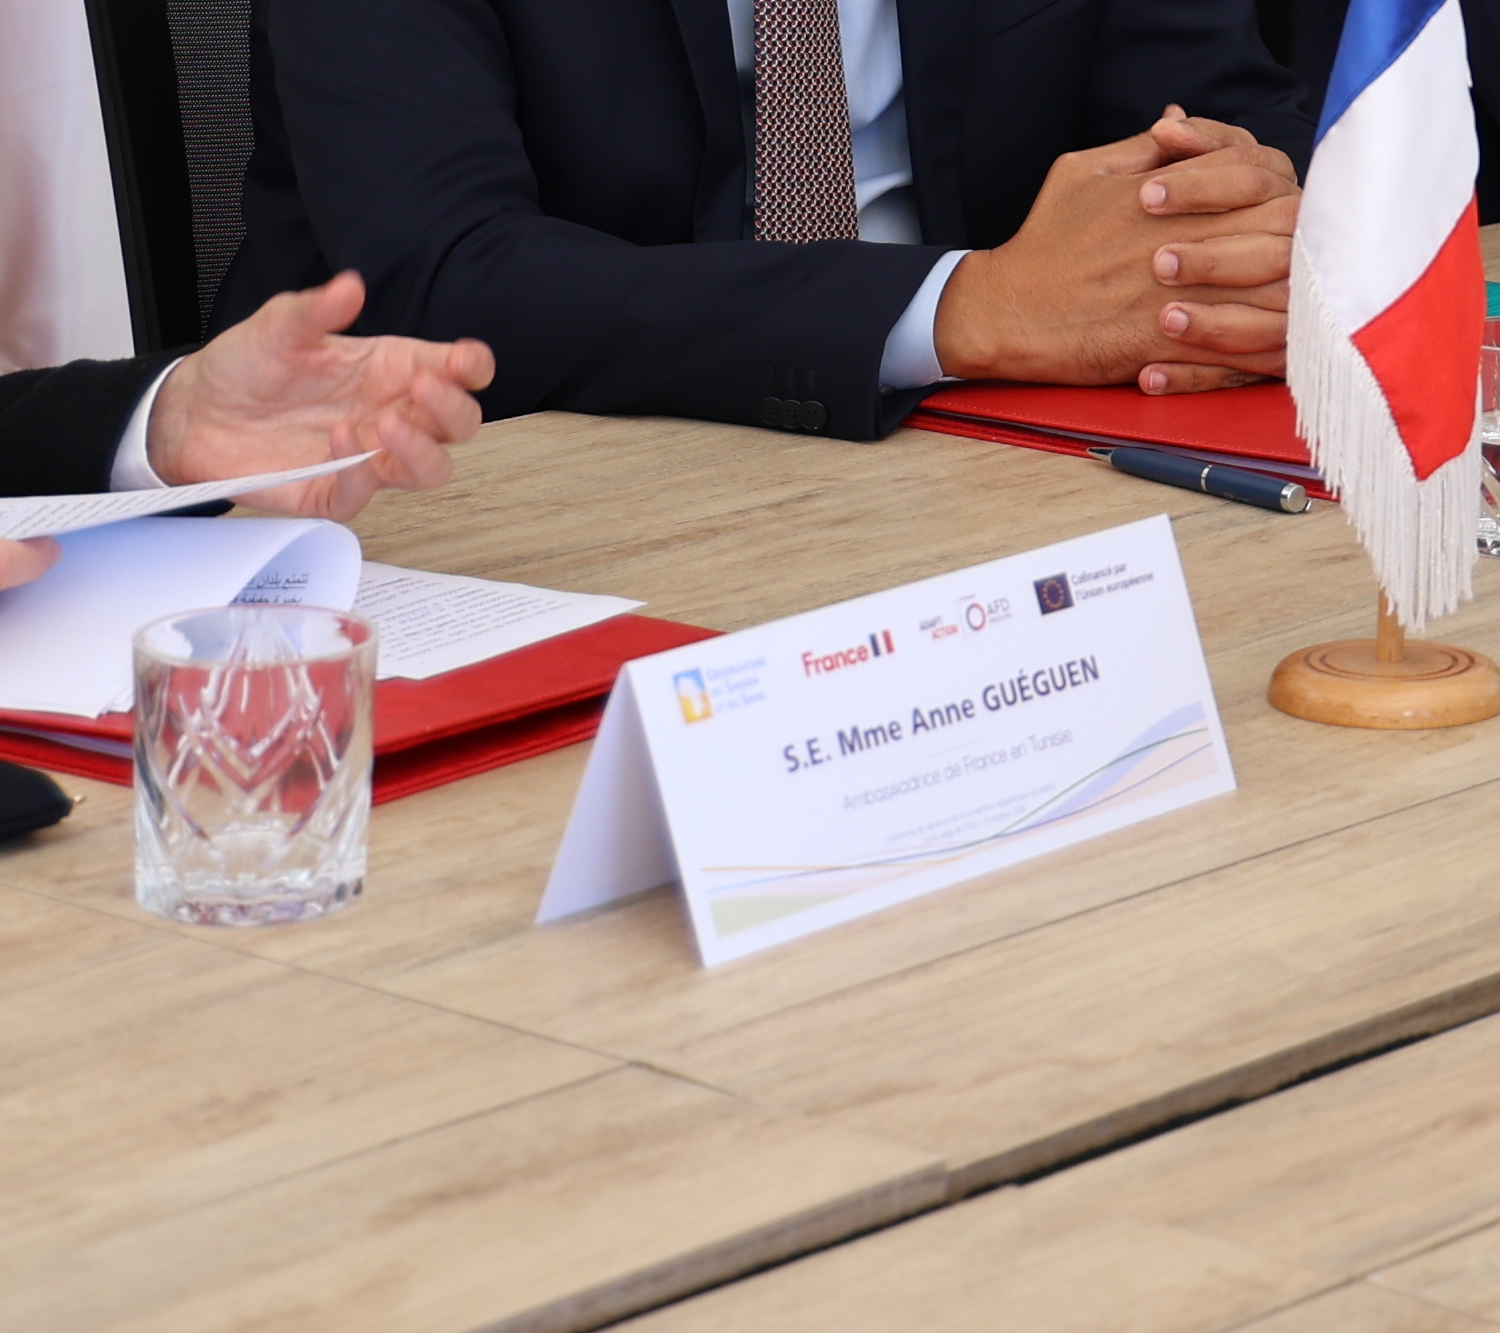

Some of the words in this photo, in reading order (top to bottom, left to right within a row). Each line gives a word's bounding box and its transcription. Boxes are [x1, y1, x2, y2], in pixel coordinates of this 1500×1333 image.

[802, 643, 868, 676] France
[784, 738, 831, 772] S.E.
[837, 722, 902, 756] Mme
[913, 699, 975, 735] Anne
[982, 655, 1099, 712] GUÉGUEN
[843, 769, 941, 811] Ambassadrice
[942, 761, 961, 778] de
[964, 747, 1008, 772] France
[1010, 743, 1029, 759] en
[1029, 728, 1072, 754] Tunisie
